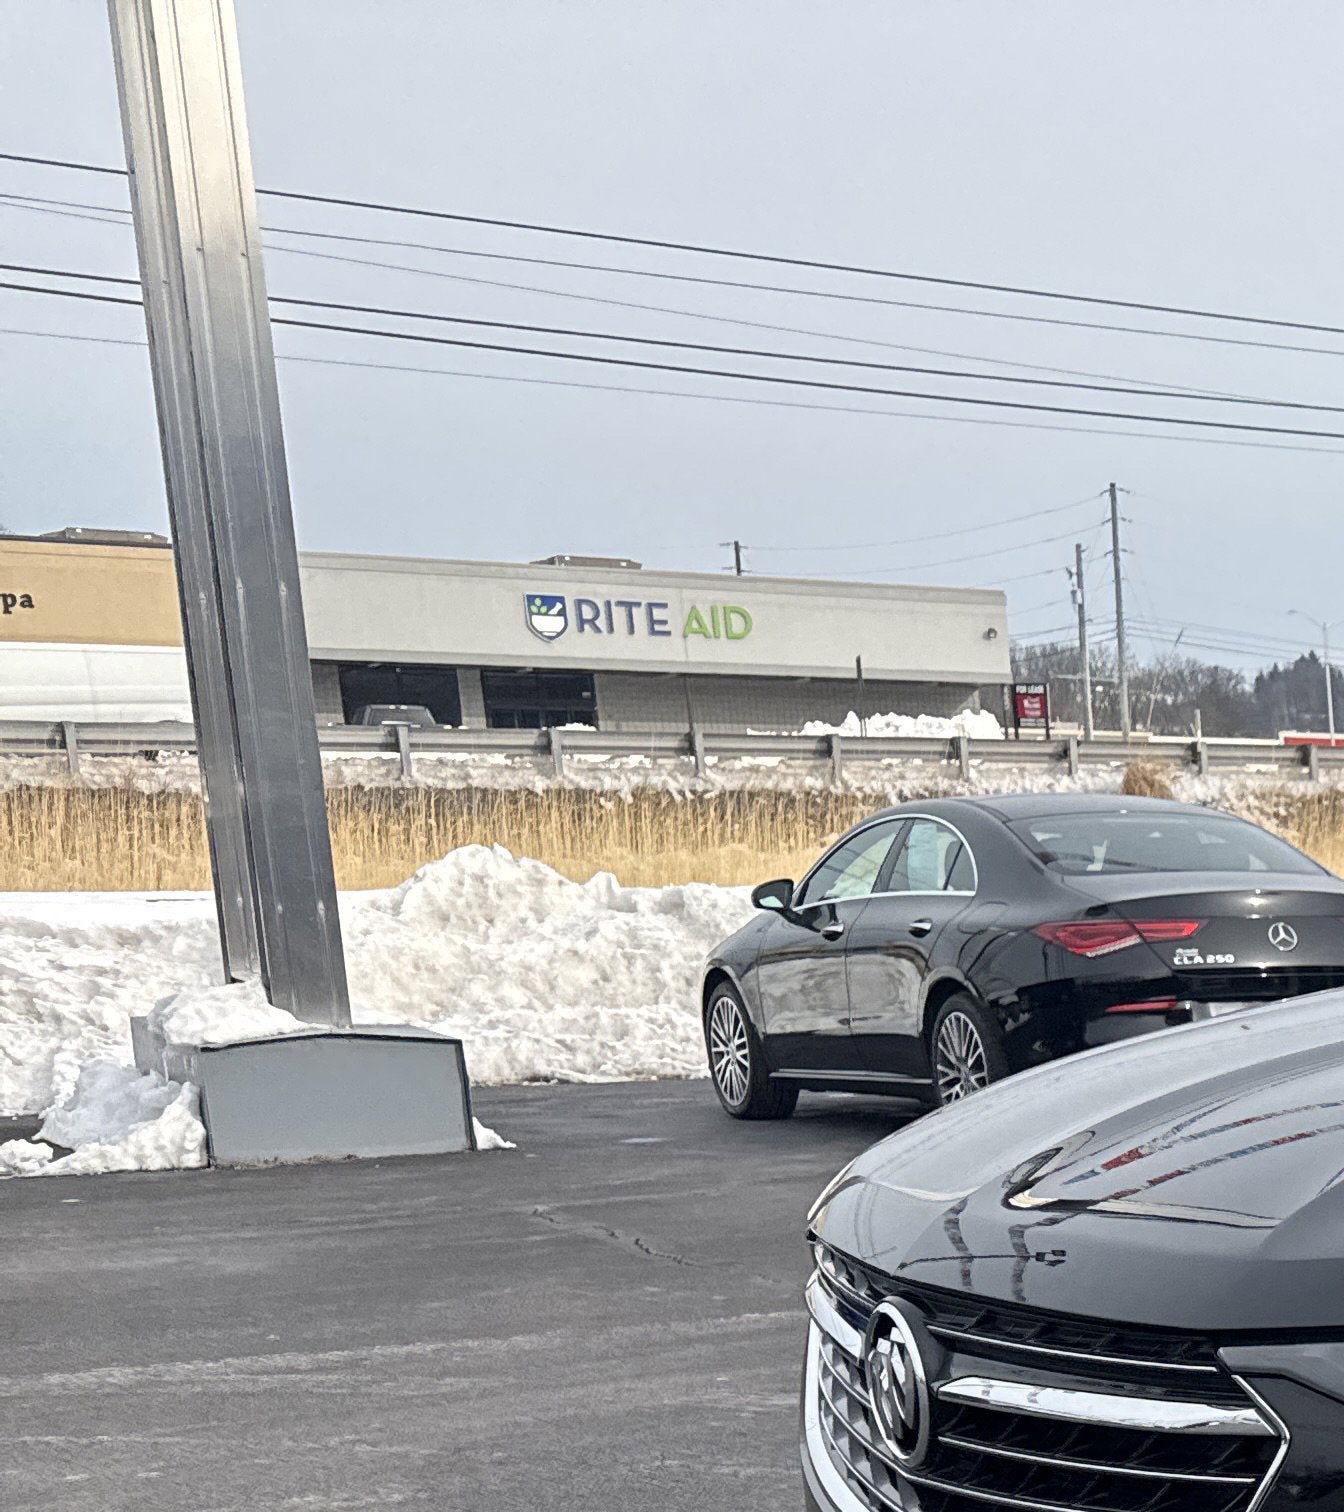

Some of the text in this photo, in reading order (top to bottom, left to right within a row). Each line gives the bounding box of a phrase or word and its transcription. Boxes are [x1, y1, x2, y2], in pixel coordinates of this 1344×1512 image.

[574, 597, 754, 640] RITE AID
[1206, 954, 1235, 964] 250
